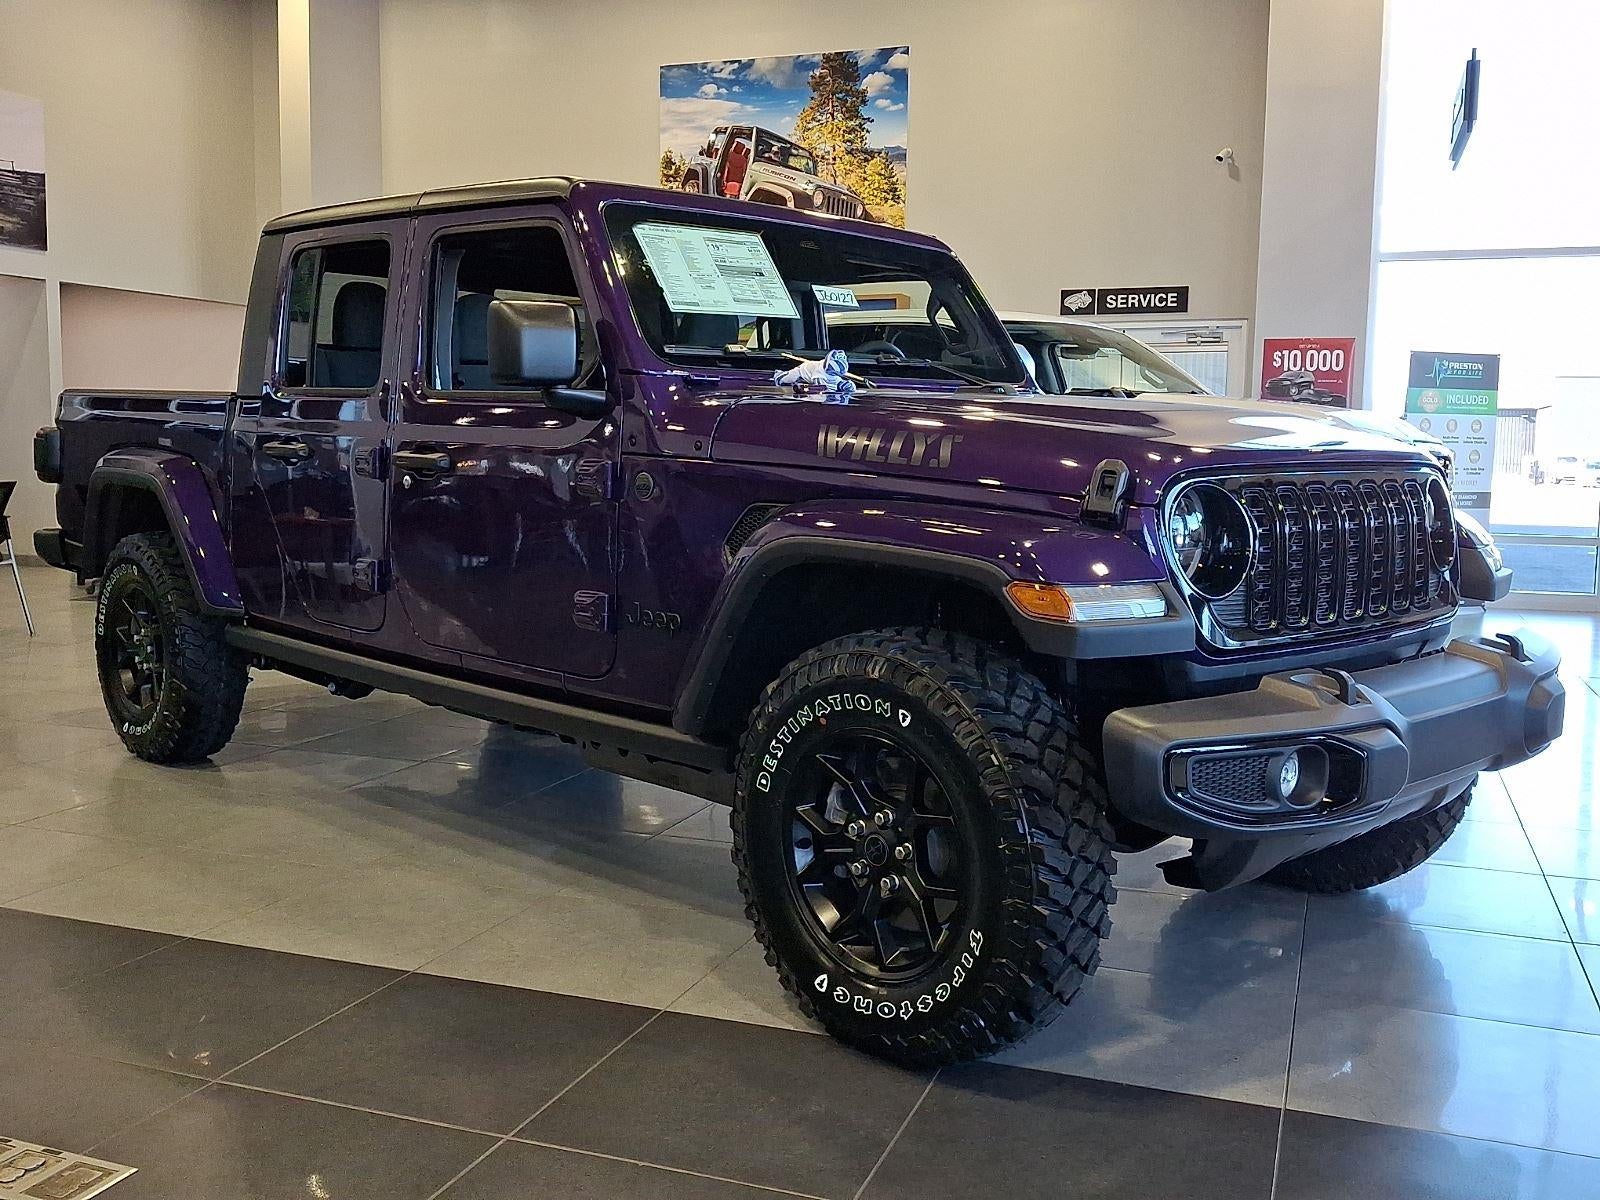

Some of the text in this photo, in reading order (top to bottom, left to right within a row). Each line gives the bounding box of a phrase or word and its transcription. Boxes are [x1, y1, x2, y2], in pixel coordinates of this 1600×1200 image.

[762, 167, 797, 182] RUBICON
[1106, 292, 1178, 309] SERVICE
[1272, 349, 1345, 372] $10,000
[1448, 362, 1484, 370] PRESTON
[1446, 394, 1489, 405] INCLUDED
[817, 424, 965, 469] WILLYS
[625, 601, 681, 639] Jeep
[756, 692, 892, 792] DESTINATION
